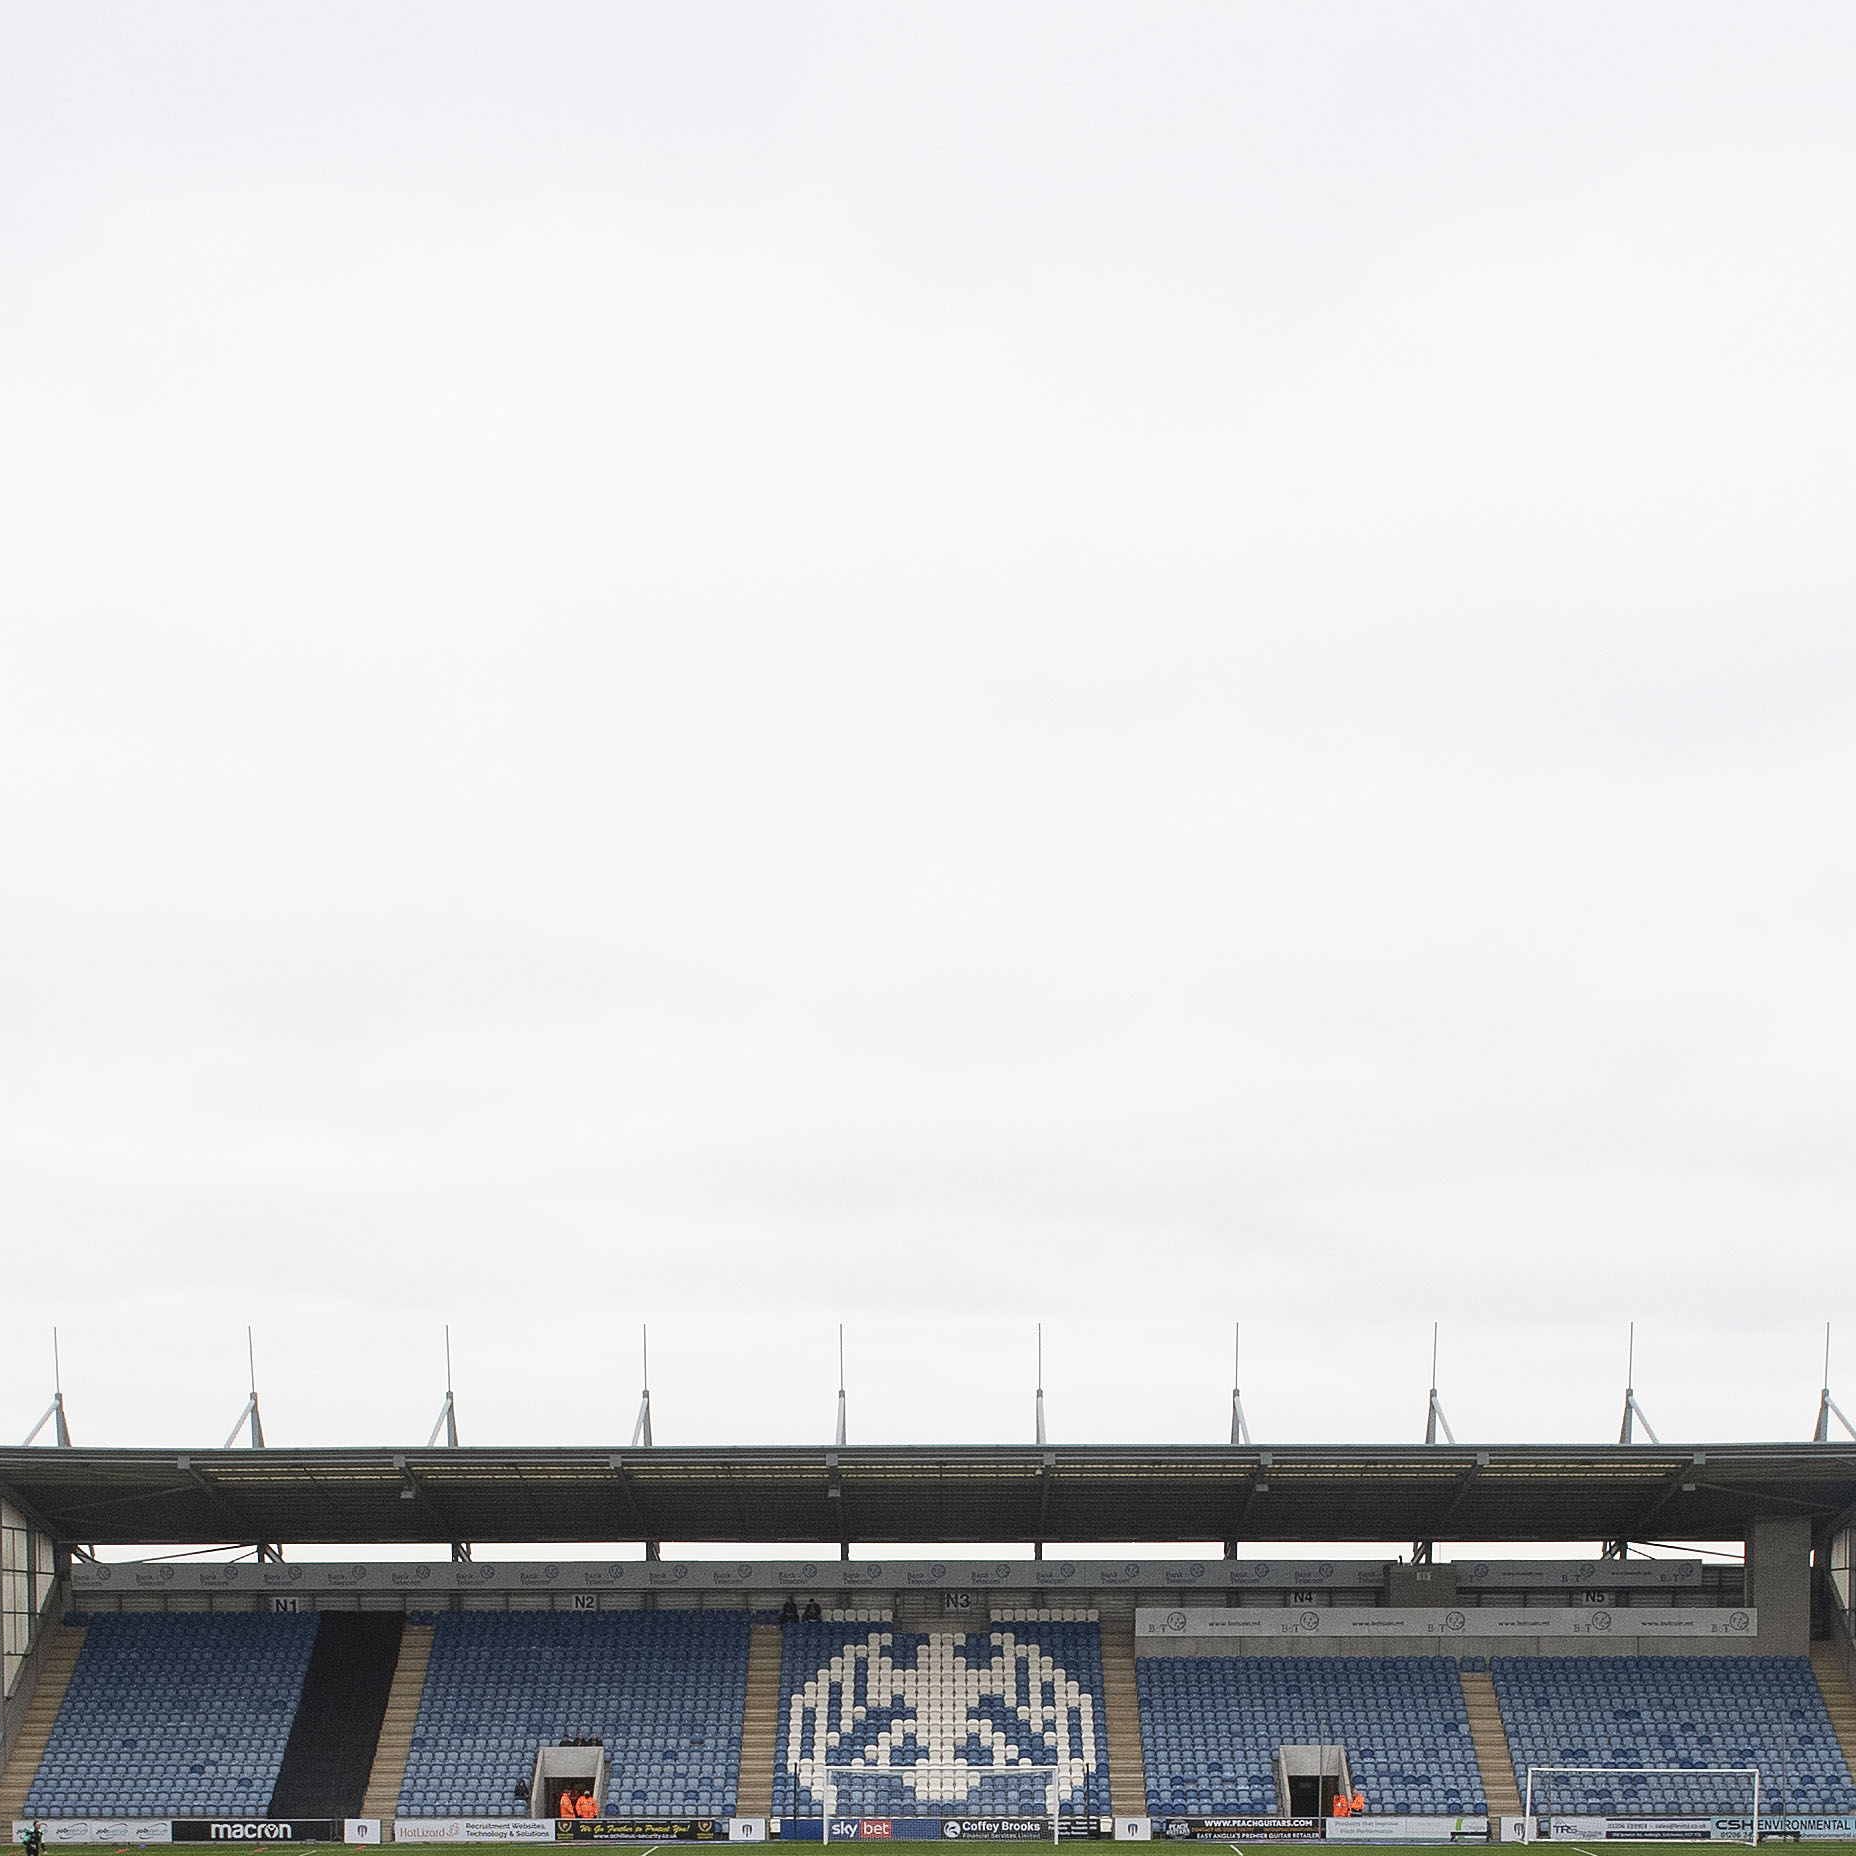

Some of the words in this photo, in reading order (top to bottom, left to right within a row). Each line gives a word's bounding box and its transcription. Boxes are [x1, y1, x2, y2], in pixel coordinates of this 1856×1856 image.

[575, 1595, 594, 1608] N2
[946, 1594, 969, 1608] N3
[1294, 1592, 1313, 1603] N4
[1585, 1591, 1605, 1603] N5
[275, 1599, 297, 1612] N1
[831, 1821, 858, 1837] sky
[863, 1821, 890, 1835] bet
[962, 1821, 999, 1833] Coffey
[1002, 1821, 1041, 1831] Brooks
[1204, 1819, 1313, 1827] WWW.PEACHGUITARS.COM
[1715, 1820, 1753, 1831] CSH
[1757, 1820, 1850, 1831] ENVIRONMENTAL
[210, 1823, 293, 1839] macron
